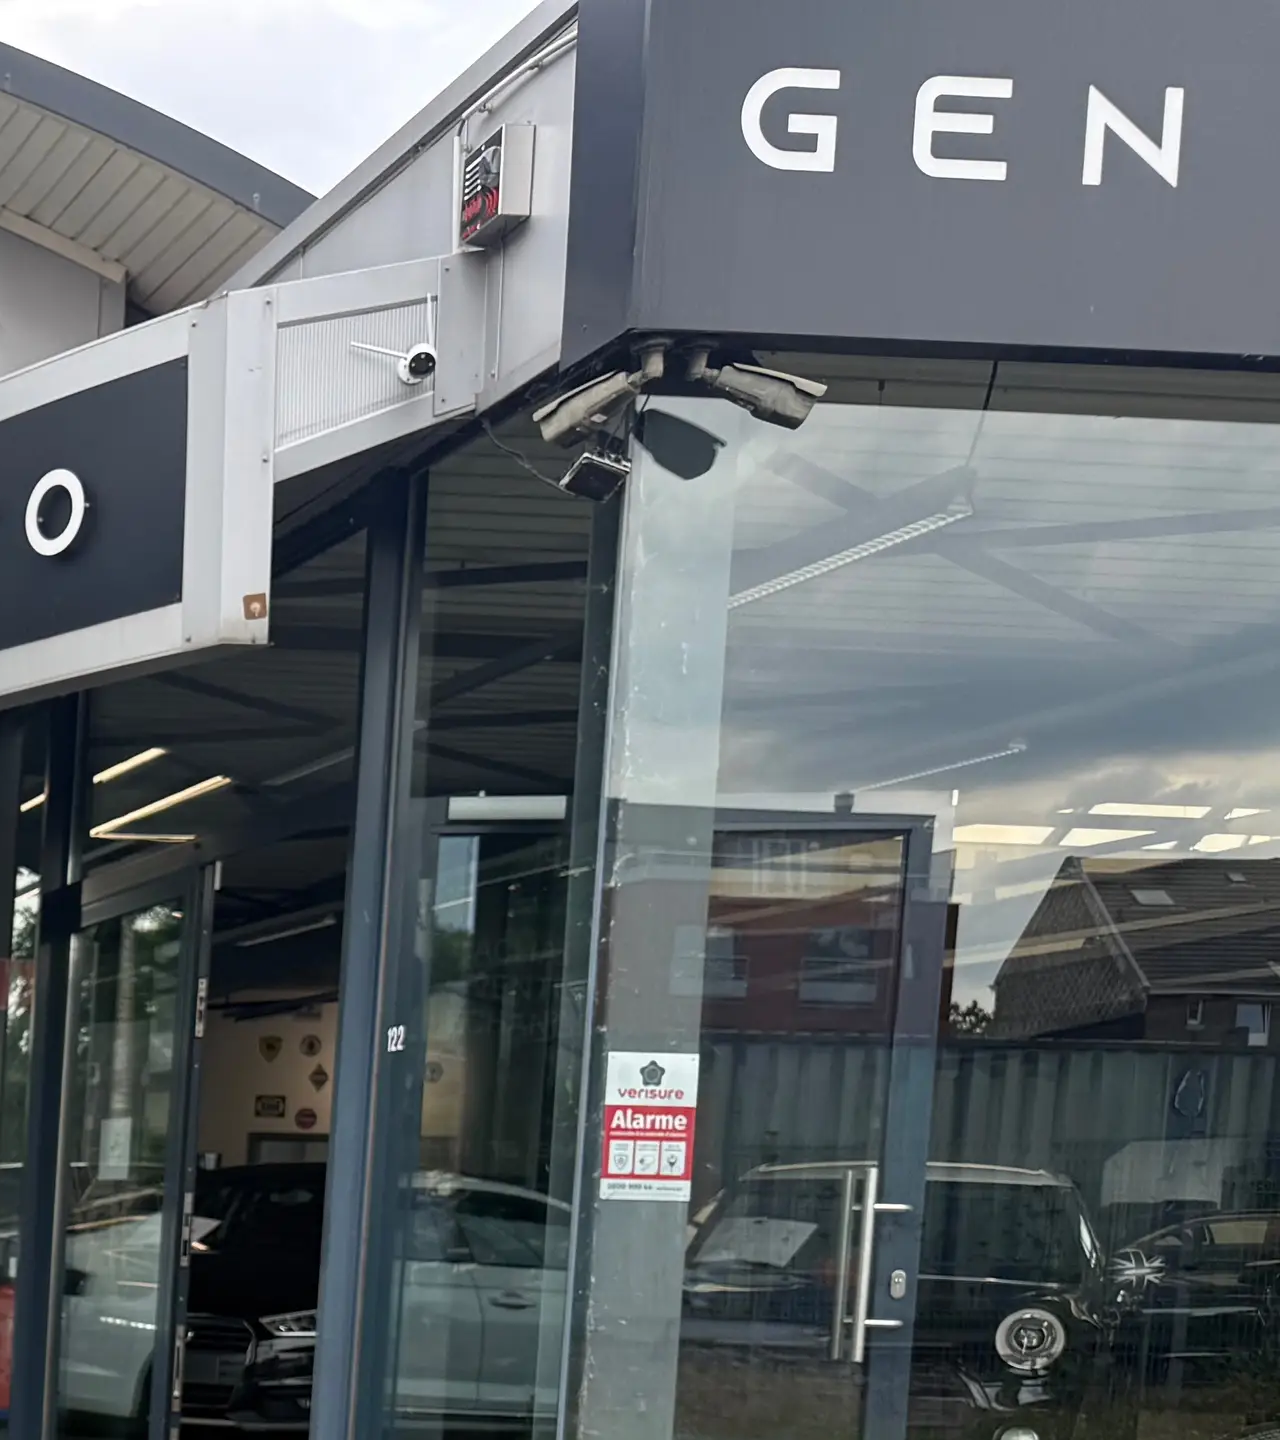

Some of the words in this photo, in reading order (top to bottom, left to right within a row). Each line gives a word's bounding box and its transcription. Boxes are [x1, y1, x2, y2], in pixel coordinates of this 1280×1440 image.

[741, 66, 1185, 188] GEN
[386, 1024, 406, 1052] 122
[617, 1087, 685, 1100] verisure
[610, 1108, 688, 1131] Alarme
